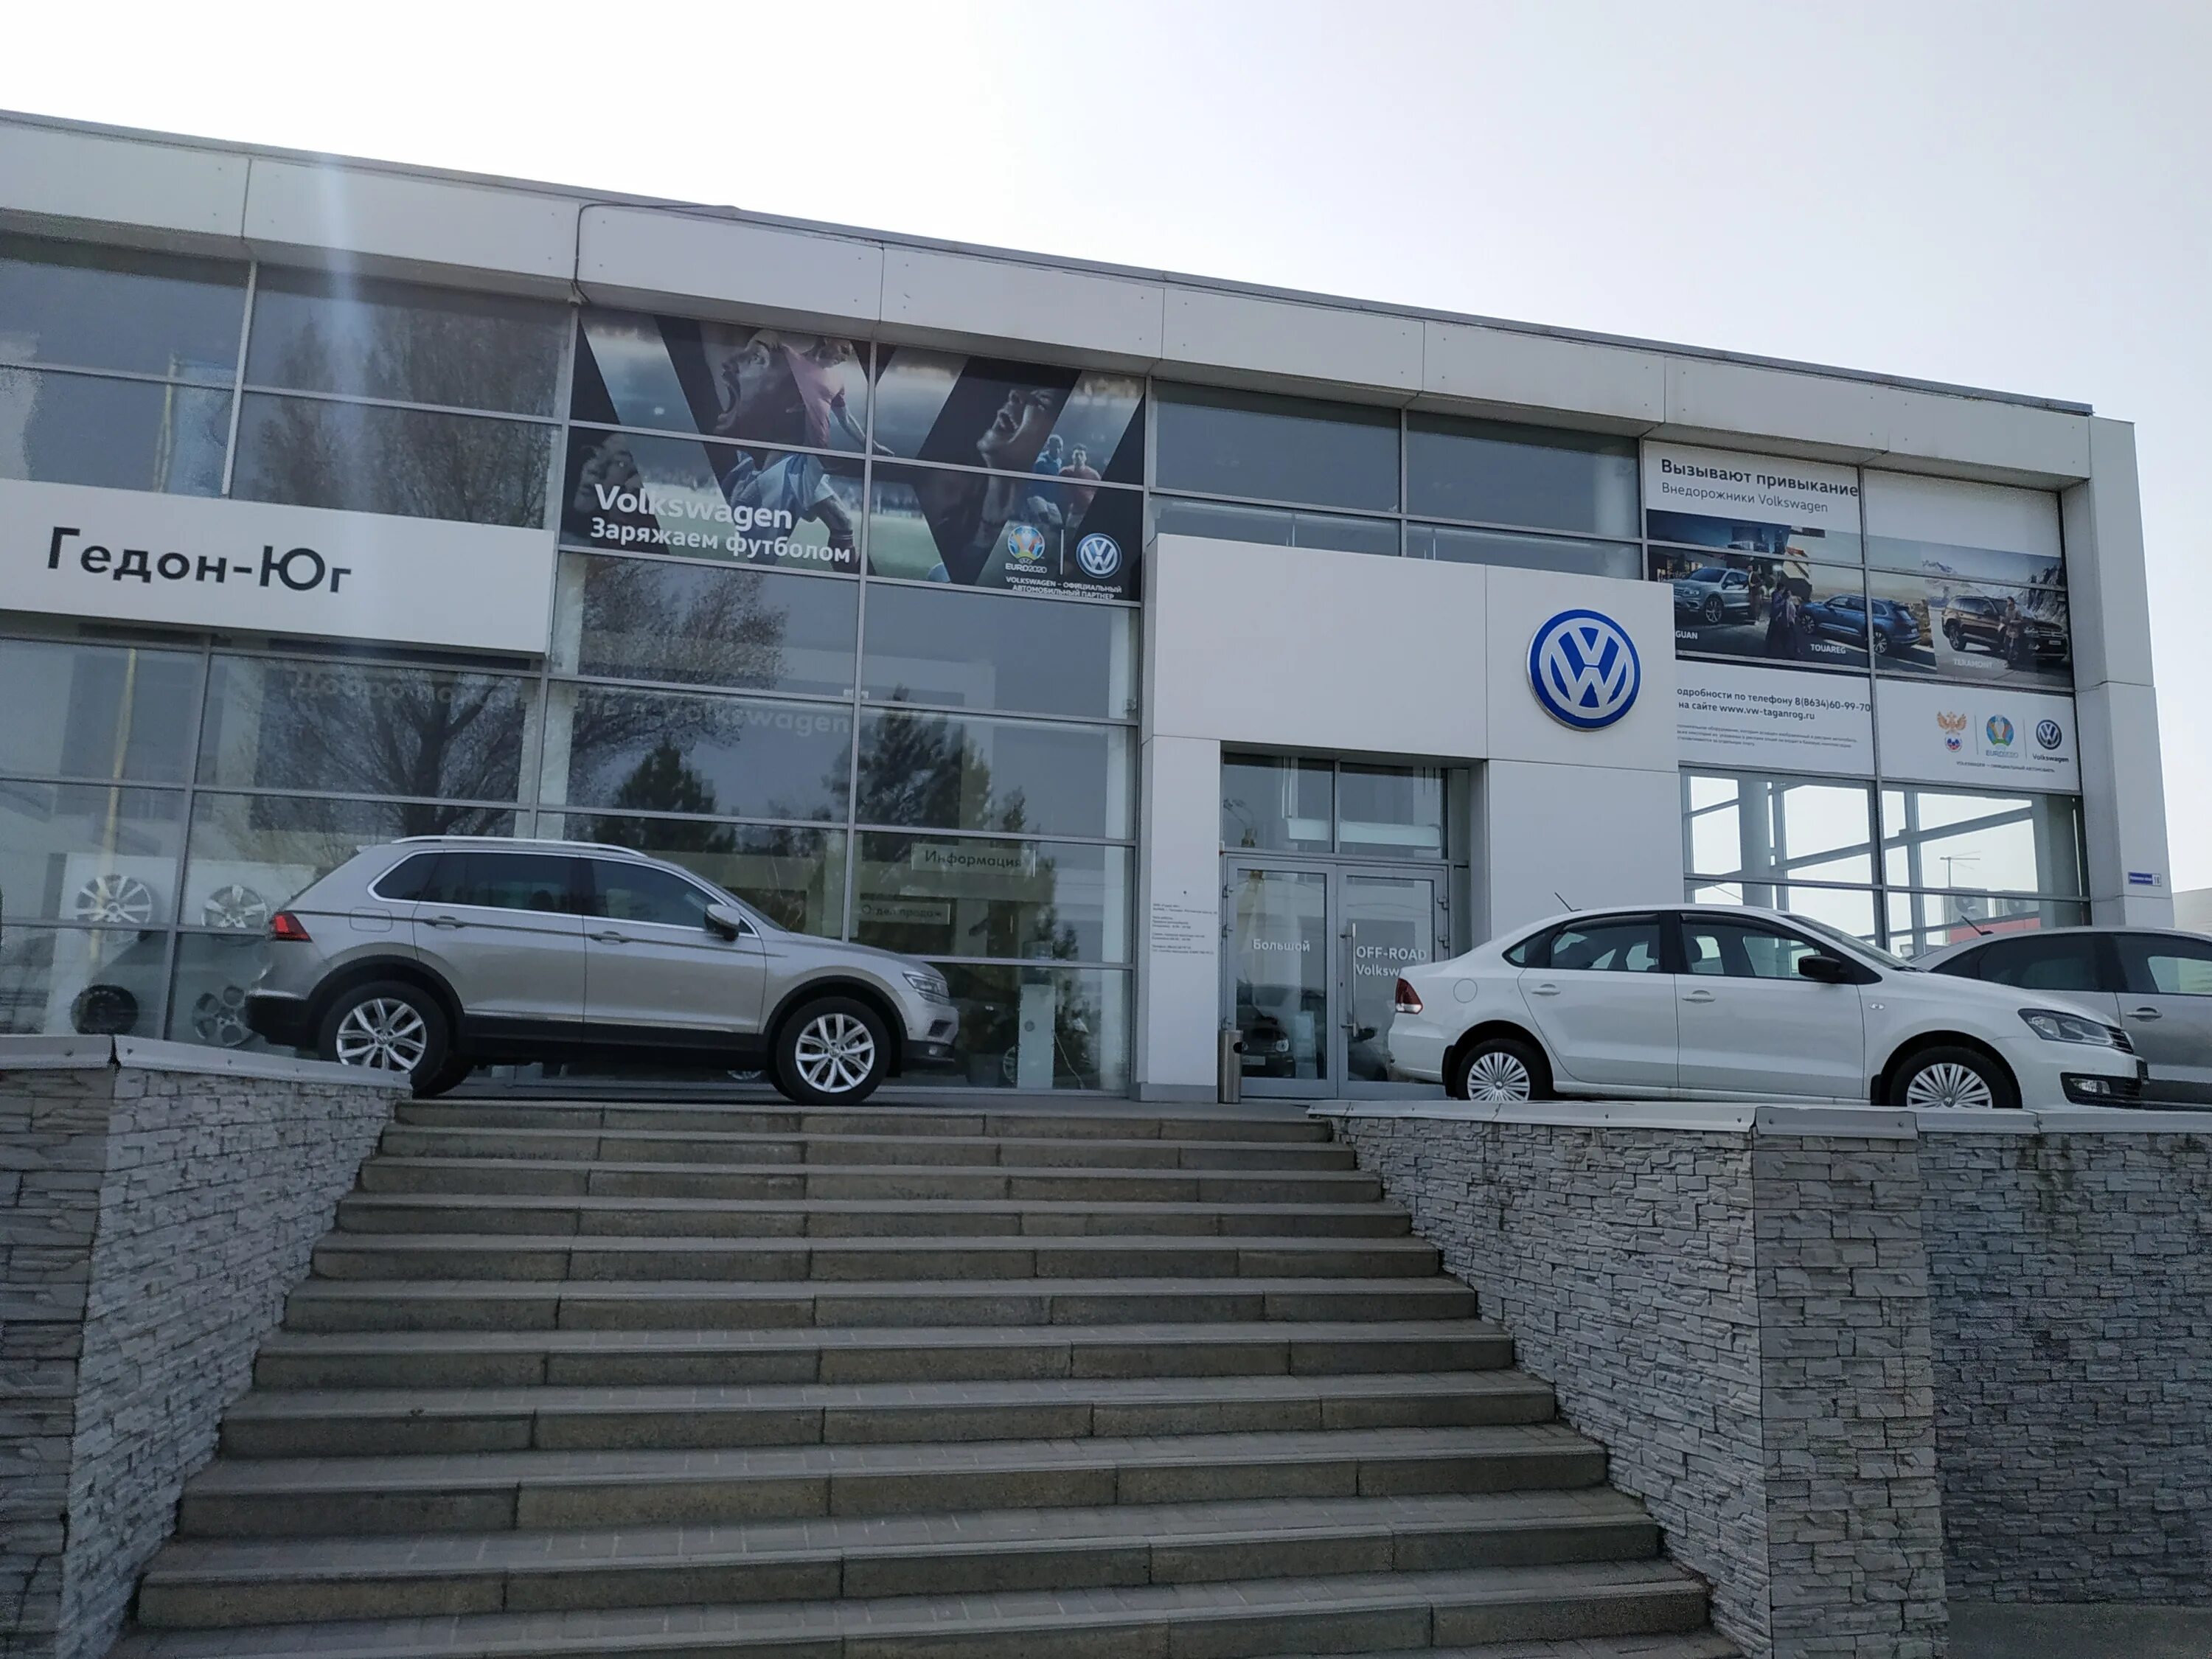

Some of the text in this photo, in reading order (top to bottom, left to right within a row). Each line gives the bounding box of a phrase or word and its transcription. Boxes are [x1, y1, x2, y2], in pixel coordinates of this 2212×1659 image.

[1660, 458, 1859, 497] Вызывают привыкание
[1661, 481, 1829, 514] Внедорожники Volkswagen
[594, 483, 793, 532] Volkswagen
[590, 516, 851, 563] Заряжаем футболом
[47, 526, 352, 593] Гедон-Юг
[1005, 563, 1048, 574] EURO2020
[1006, 576, 1056, 587] VOLKSWAGEN
[1062, 582, 1122, 594] ОФИЦИАЛЬНЫЙ
[1012, 585, 1115, 600] АВТОМОБИЛЬНЫЙ ПАРТНЕР
[1674, 630, 1698, 640] GUAN
[1810, 643, 1846, 654] TOUAREG
[1676, 688, 1871, 712] одробности по телефону 8(8634)60-99-70
[1678, 701, 1815, 721] на сайте www.vw-taganrog.ru
[2032, 754, 2070, 764] Volkswagen
[925, 849, 1022, 868] Информация
[1253, 938, 1310, 953] Большой
[1355, 945, 1427, 961] OFF-ROAD
[1355, 963, 1400, 977] Volksw
